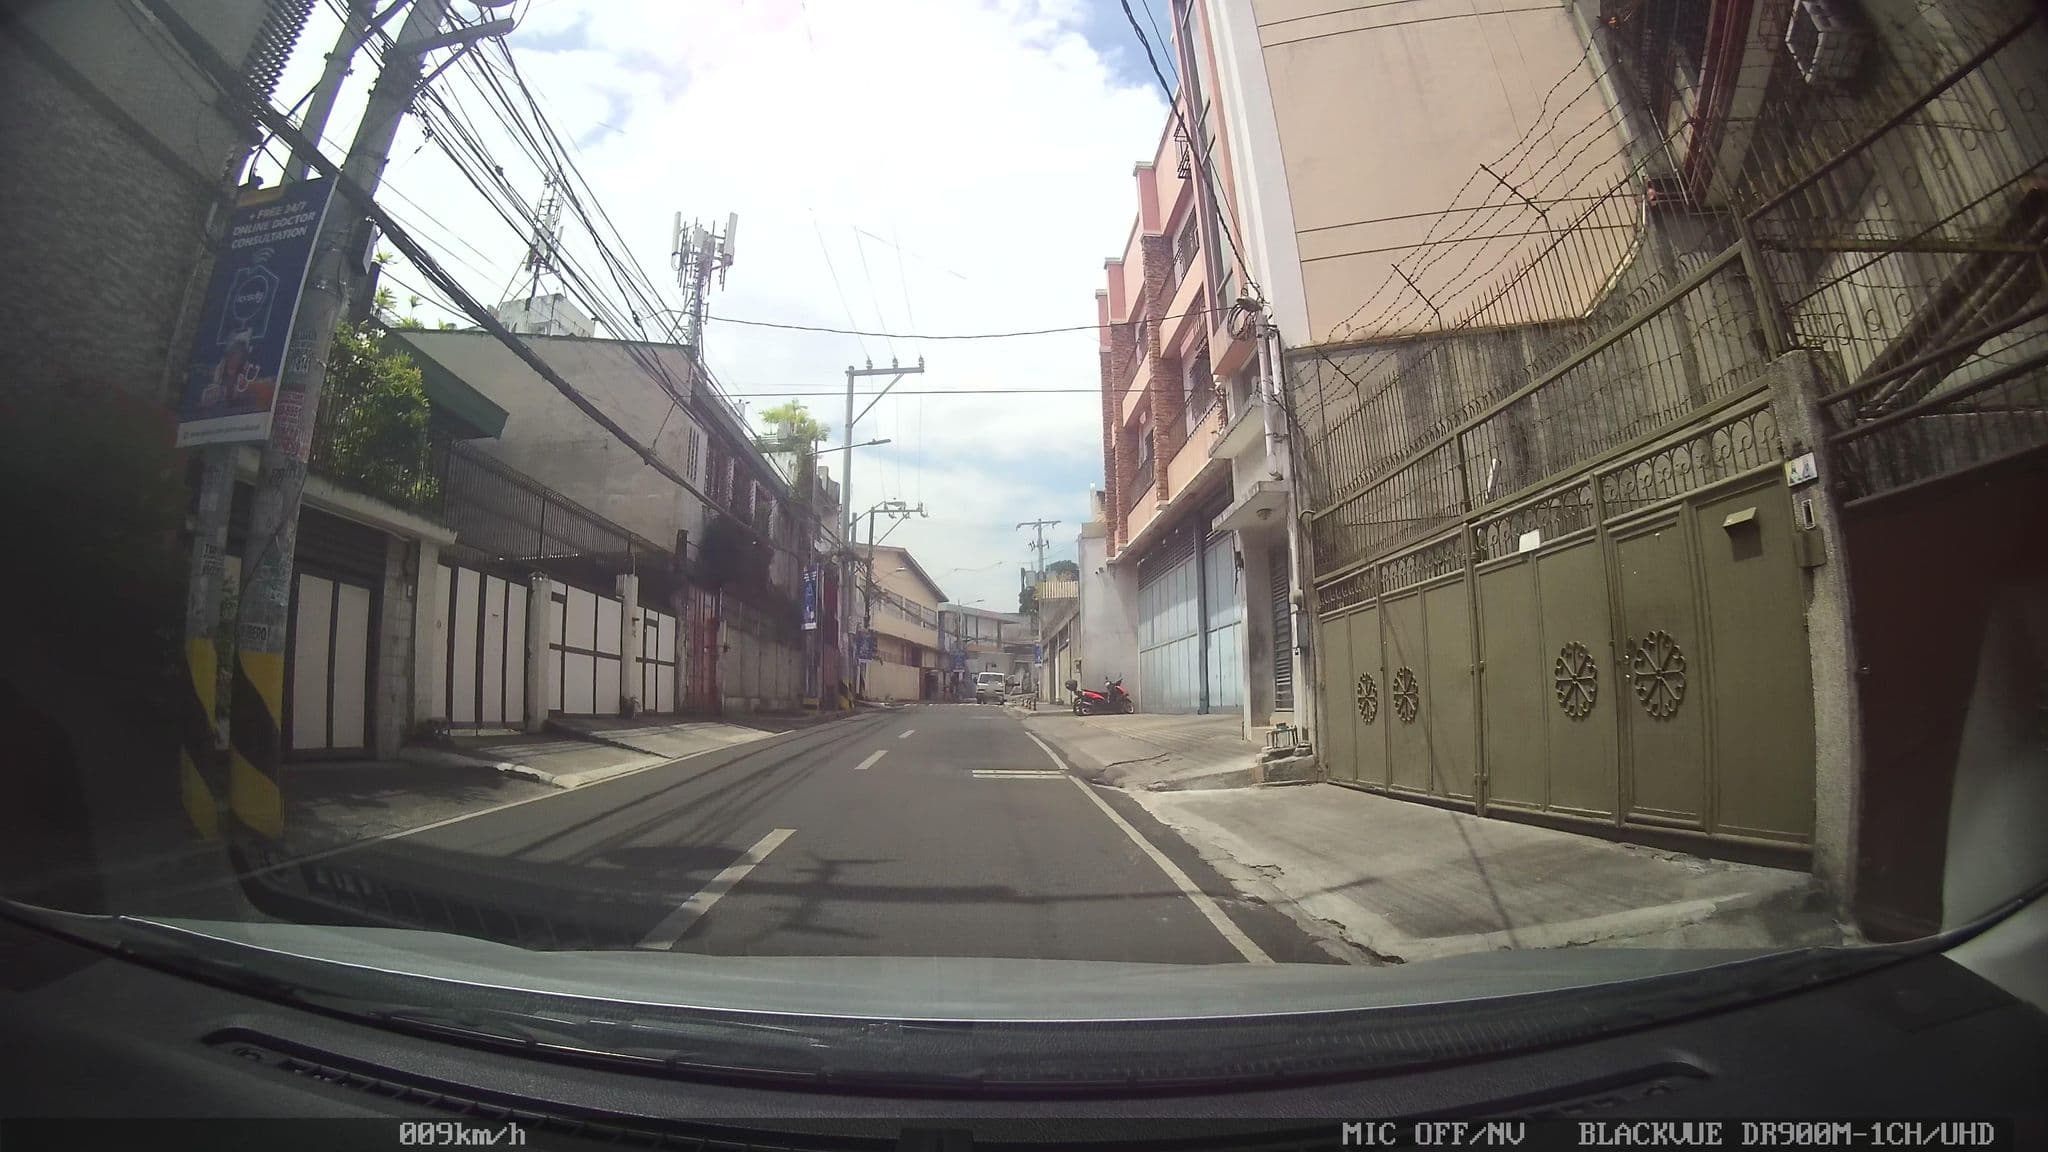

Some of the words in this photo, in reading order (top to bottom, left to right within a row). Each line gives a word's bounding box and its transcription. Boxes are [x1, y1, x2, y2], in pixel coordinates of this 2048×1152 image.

[257, 206, 284, 218] FREE
[284, 201, 307, 213] 24/7
[232, 222, 269, 236] ONLINE
[272, 212, 316, 228] DOCTOR
[231, 225, 308, 249] CONSULTATION
